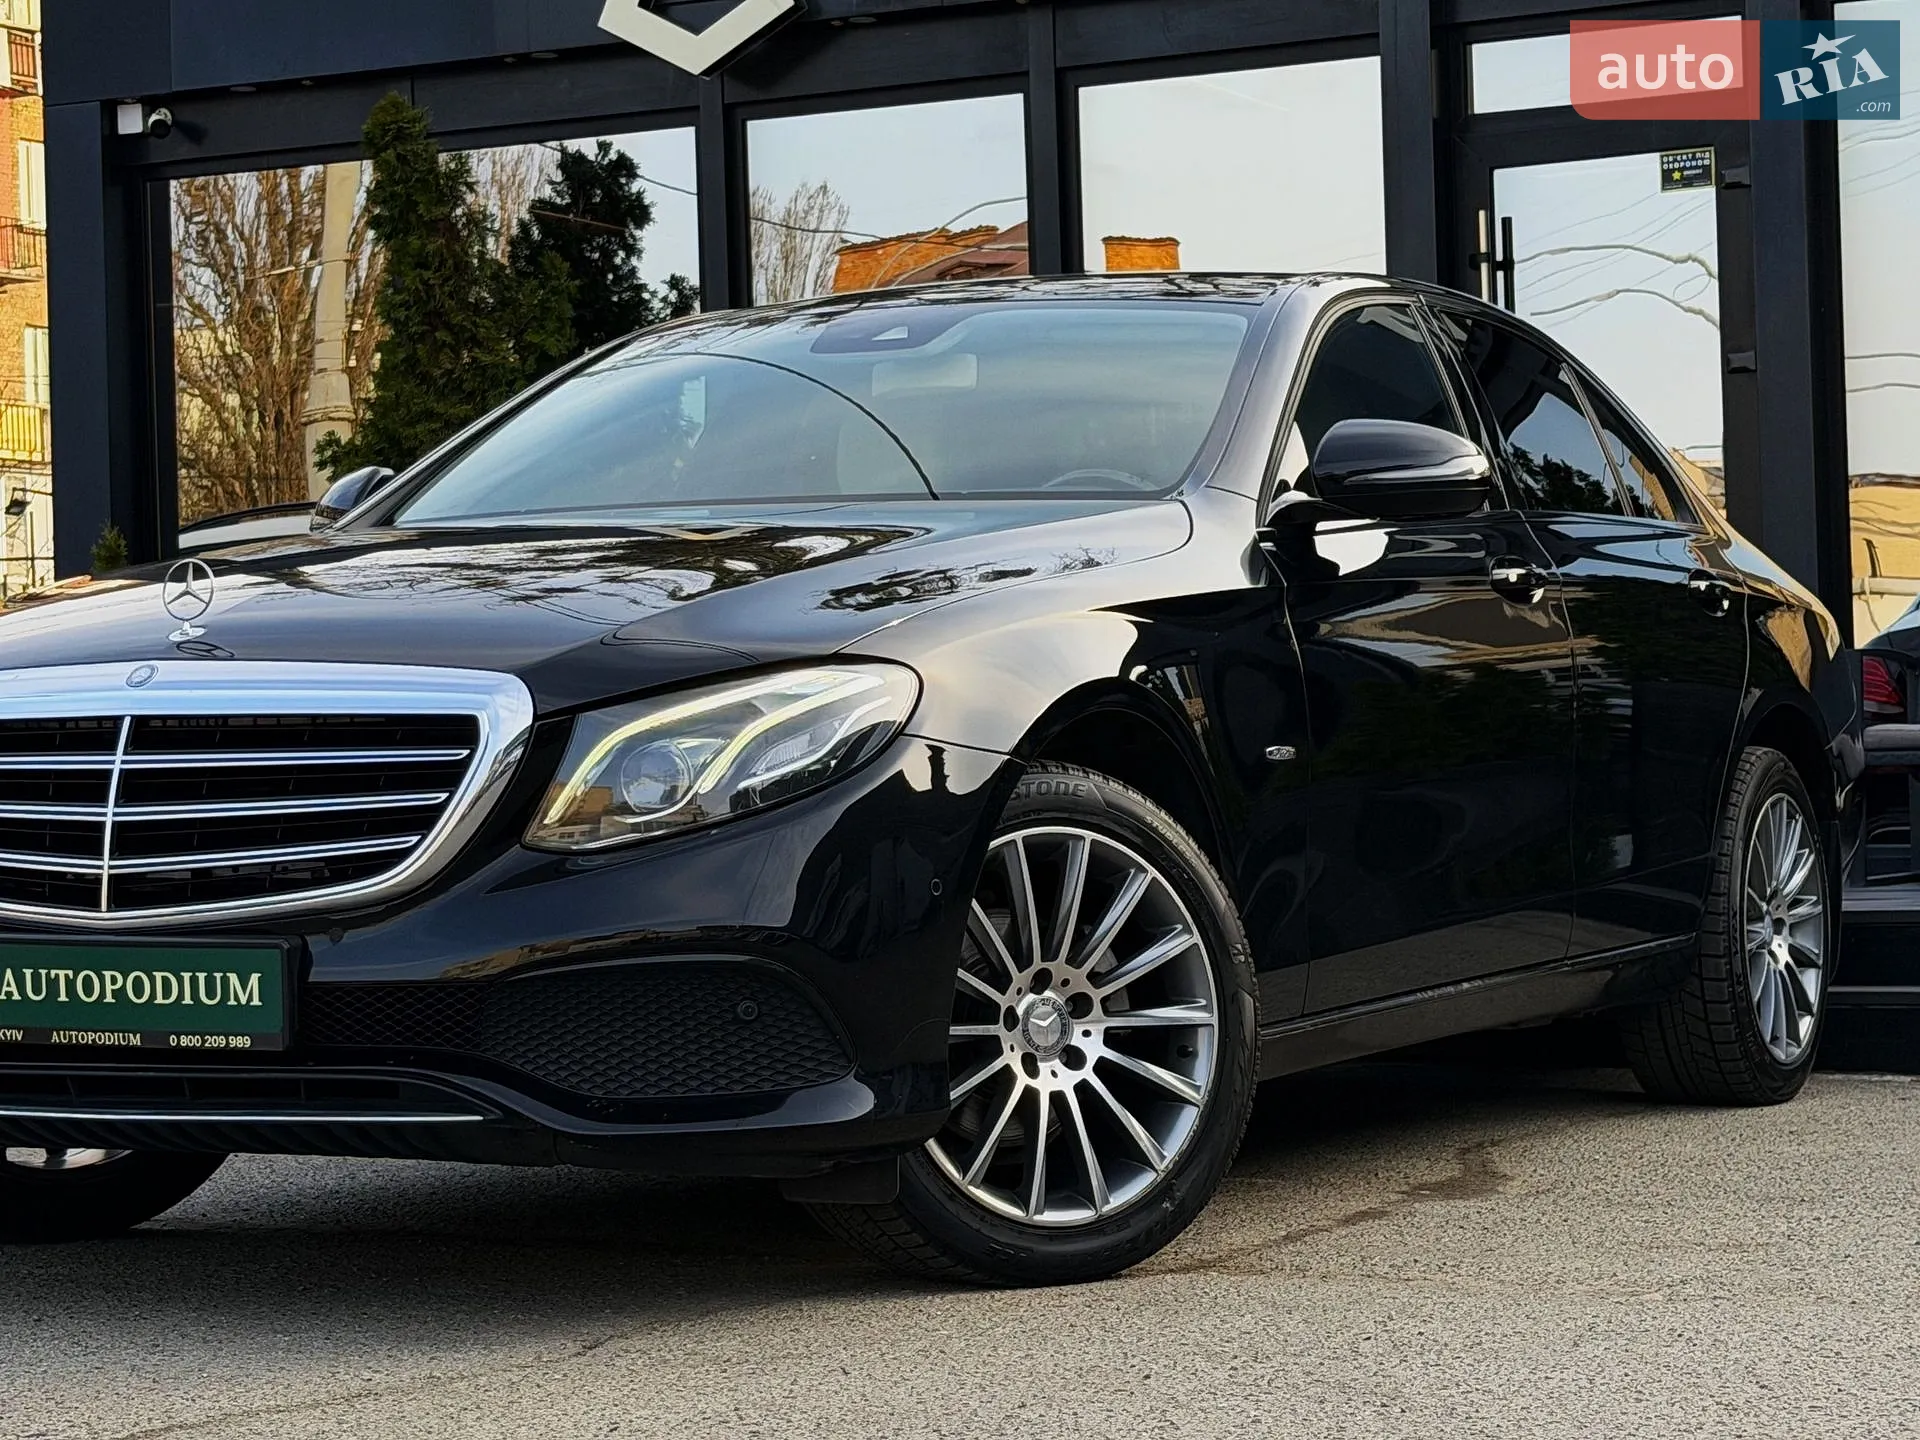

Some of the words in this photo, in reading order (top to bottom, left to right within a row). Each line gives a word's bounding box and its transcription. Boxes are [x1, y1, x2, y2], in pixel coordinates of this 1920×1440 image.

[0, 967, 263, 1006] AUTOPODIUM
[51, 1030, 141, 1046] AUTOPODIUM
[169, 1034, 178, 1047] 0
[179, 1035, 202, 1047] 800
[204, 1035, 226, 1047] 209
[228, 1036, 251, 1048] 989
